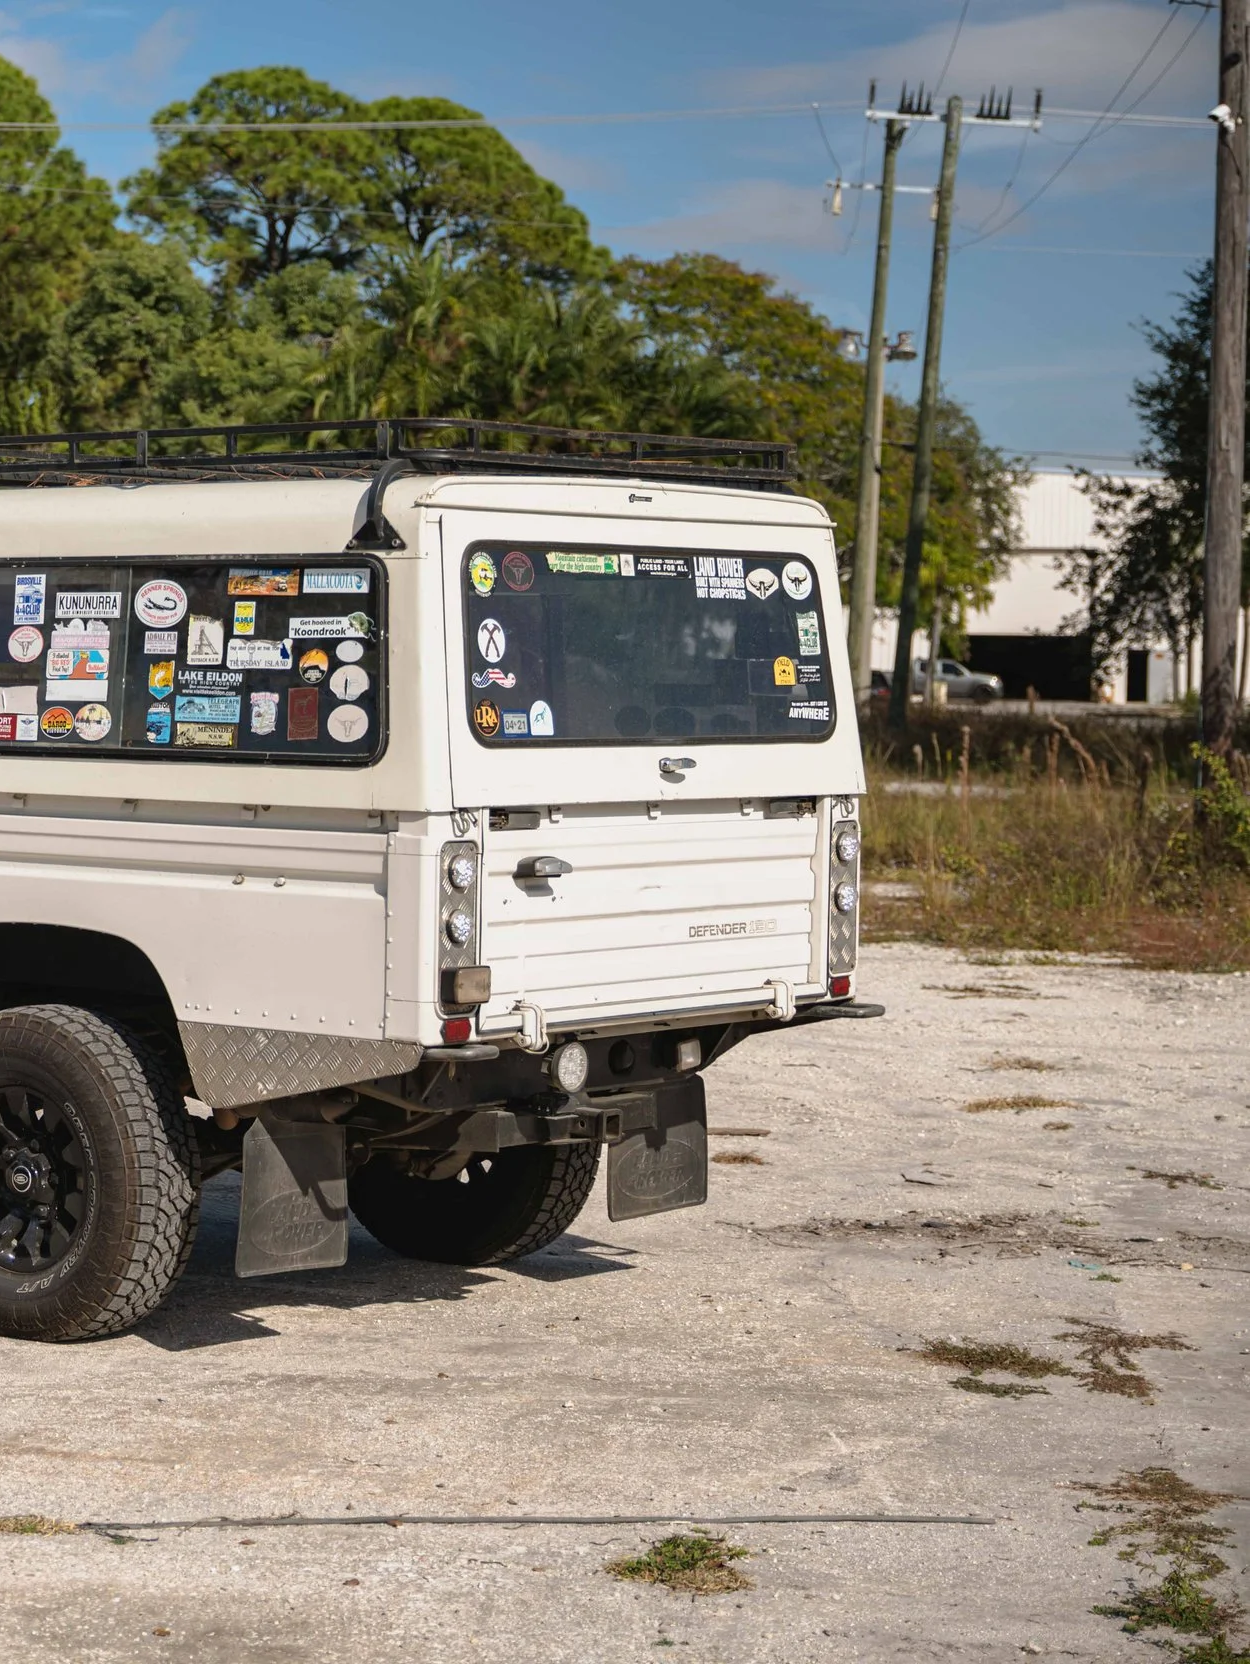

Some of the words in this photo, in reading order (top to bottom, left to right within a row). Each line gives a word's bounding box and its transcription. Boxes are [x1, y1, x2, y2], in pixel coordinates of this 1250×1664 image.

[574, 562, 584, 571] high
[584, 564, 602, 572] country
[693, 556, 716, 576] LAND
[716, 557, 744, 578] ROVER
[17, 576, 42, 586] BIRDSVILLE
[306, 572, 353, 588] MALLACOOTA
[695, 577, 708, 587] BUILT
[708, 578, 720, 588] WITH
[721, 578, 745, 588] SPANNERS
[141, 585, 162, 598] RENNER
[163, 585, 183, 603] SPRINGS
[696, 588, 708, 598] NOT
[710, 588, 746, 600] CHOPSTICKS
[58, 596, 118, 610] KUNUNURRA
[291, 627, 350, 636] "Koondrook"
[230, 659, 261, 667] THURSDAY
[178, 670, 203, 680] LAKE
[206, 672, 242, 682] EILDON
[476, 706, 498, 727] LRA
[789, 707, 829, 720] ANYWHERE
[505, 720, 514, 730] 04
[518, 720, 526, 730] 21
[688, 922, 747, 938] DEFENDER
[64, 1102, 94, 1167] OPEN
[60, 1171, 96, 1279] COUNTRY
[16, 1273, 55, 1294] A/T
